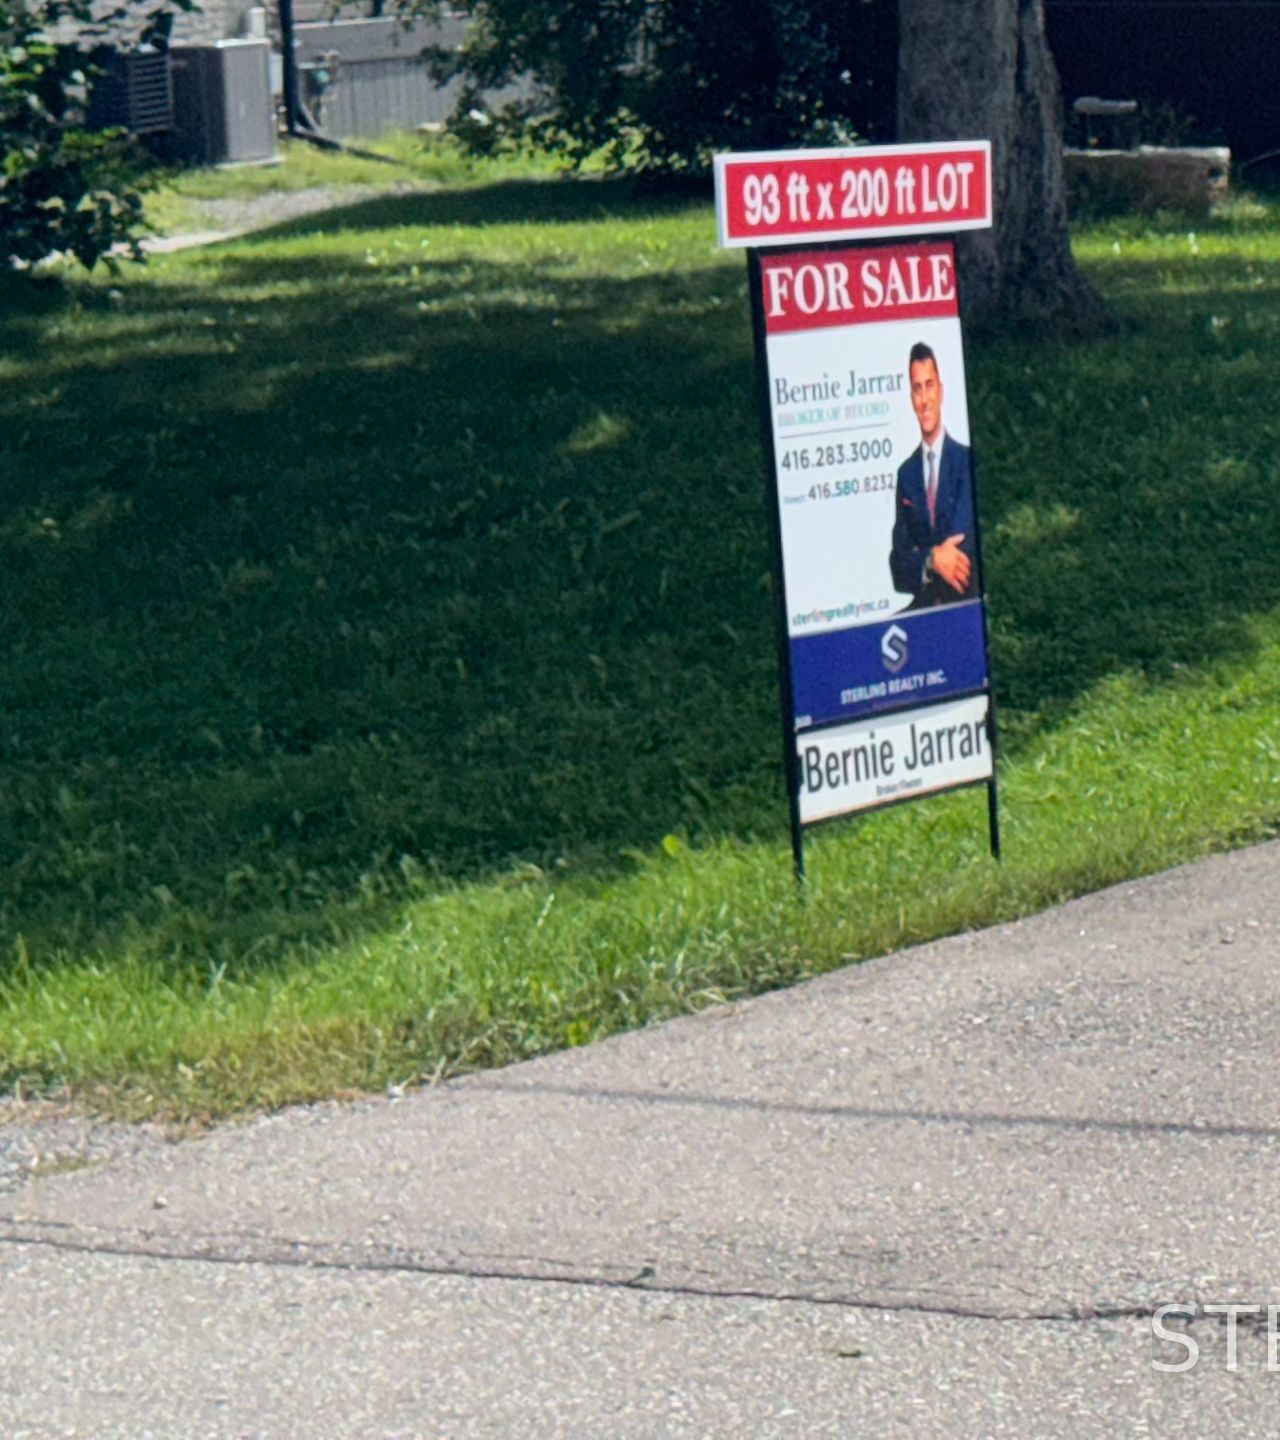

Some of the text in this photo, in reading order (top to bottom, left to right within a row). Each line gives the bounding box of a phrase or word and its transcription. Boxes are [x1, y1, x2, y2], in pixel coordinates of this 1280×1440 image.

[743, 162, 974, 226] 93 ft x 200 ft LOT
[766, 254, 956, 317] FOR SALE
[775, 370, 904, 405] Bernie Jarrar
[781, 438, 893, 471] 416.283.3000
[841, 681, 887, 705] STERLING
[888, 674, 925, 694] REALTY
[805, 719, 986, 794] Bernie Jarrar
